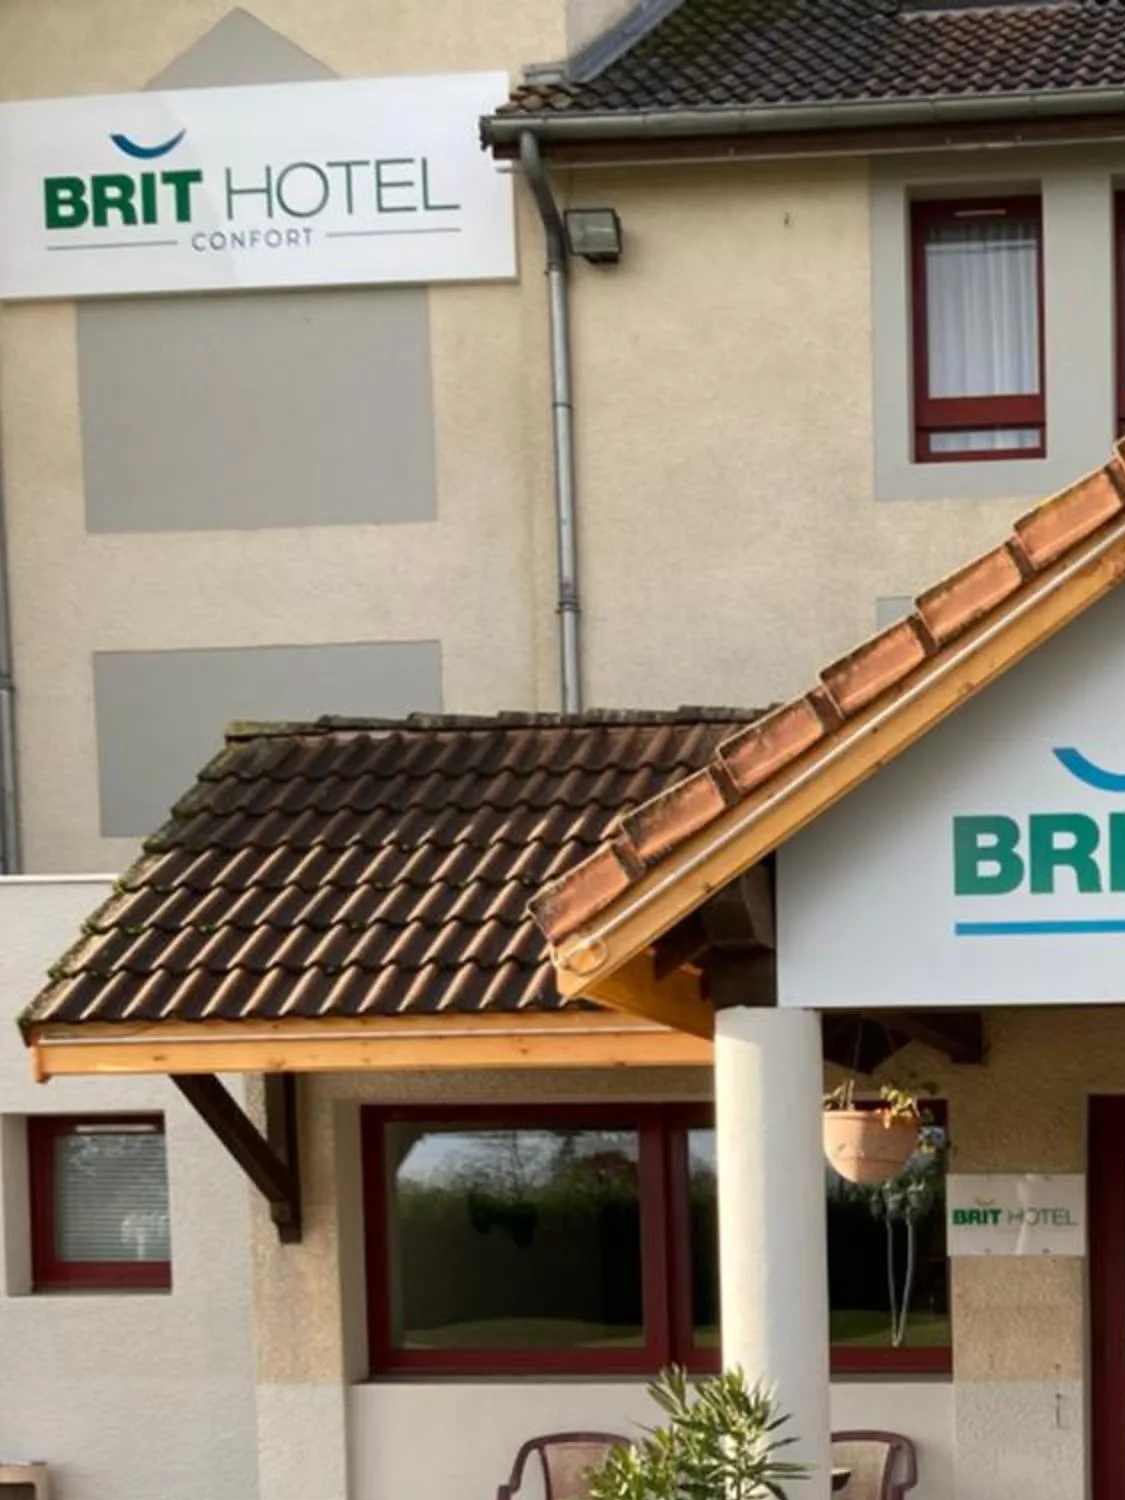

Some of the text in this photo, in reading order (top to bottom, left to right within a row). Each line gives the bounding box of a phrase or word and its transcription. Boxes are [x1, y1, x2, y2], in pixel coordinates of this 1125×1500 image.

[44, 157, 461, 229] BRIT HOTEL
[191, 227, 314, 252] CONFORT
[952, 1208, 1079, 1226] BRIT HOTEL
